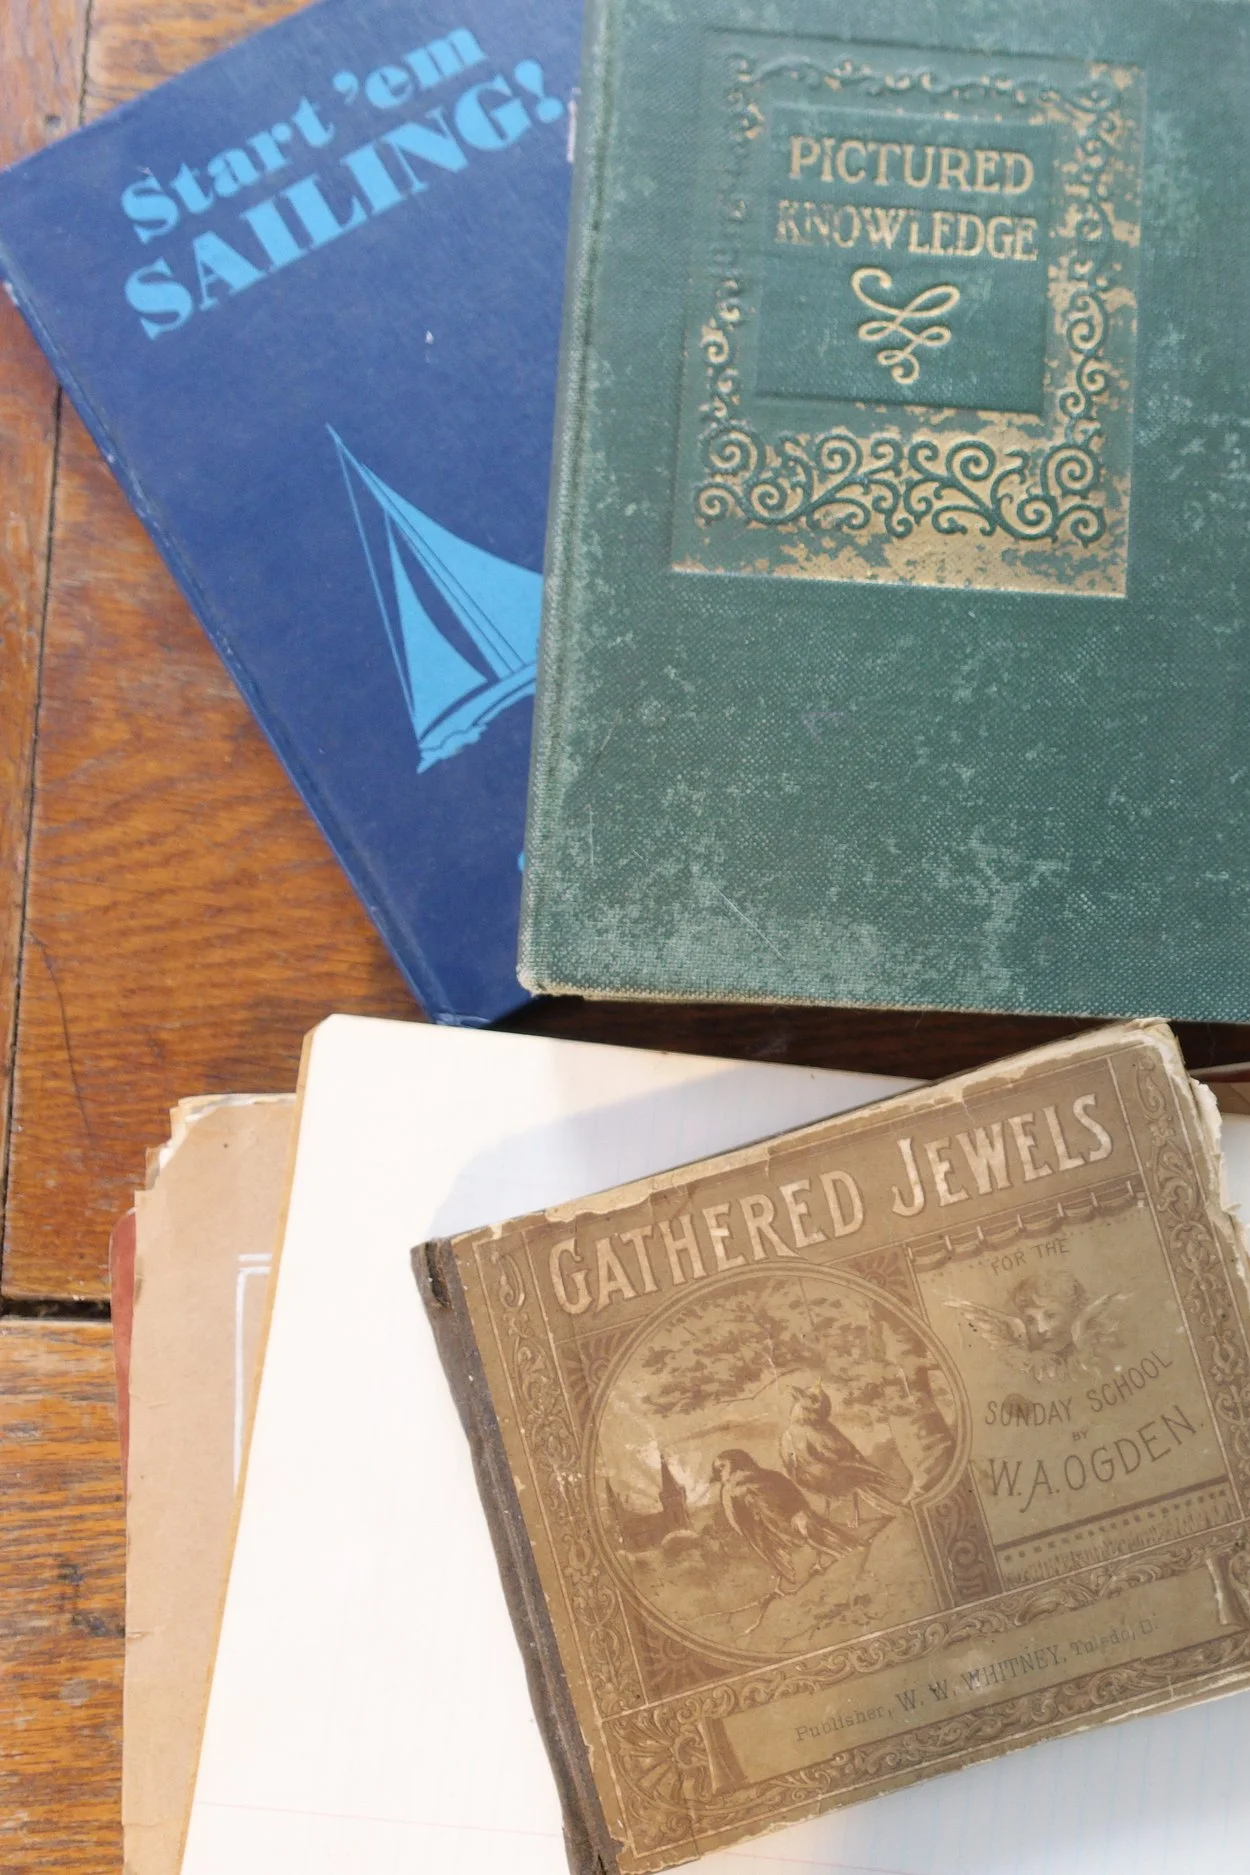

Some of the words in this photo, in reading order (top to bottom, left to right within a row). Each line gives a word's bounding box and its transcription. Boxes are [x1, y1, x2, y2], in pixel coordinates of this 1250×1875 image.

[121, 95, 336, 244] Start
[788, 136, 1034, 195] PICTURED
[124, 59, 564, 341] SAILING!
[774, 200, 1038, 261] KNOWLEDGE
[549, 1170, 865, 1314] GATHERED
[891, 1093, 1114, 1217] JEWELS
[991, 1251, 1027, 1276] FOR
[1035, 1238, 1069, 1258] THE
[985, 1397, 1073, 1427] SUNDAY
[1086, 1351, 1173, 1413] SCHOOL
[1072, 1430, 1088, 1443] BY
